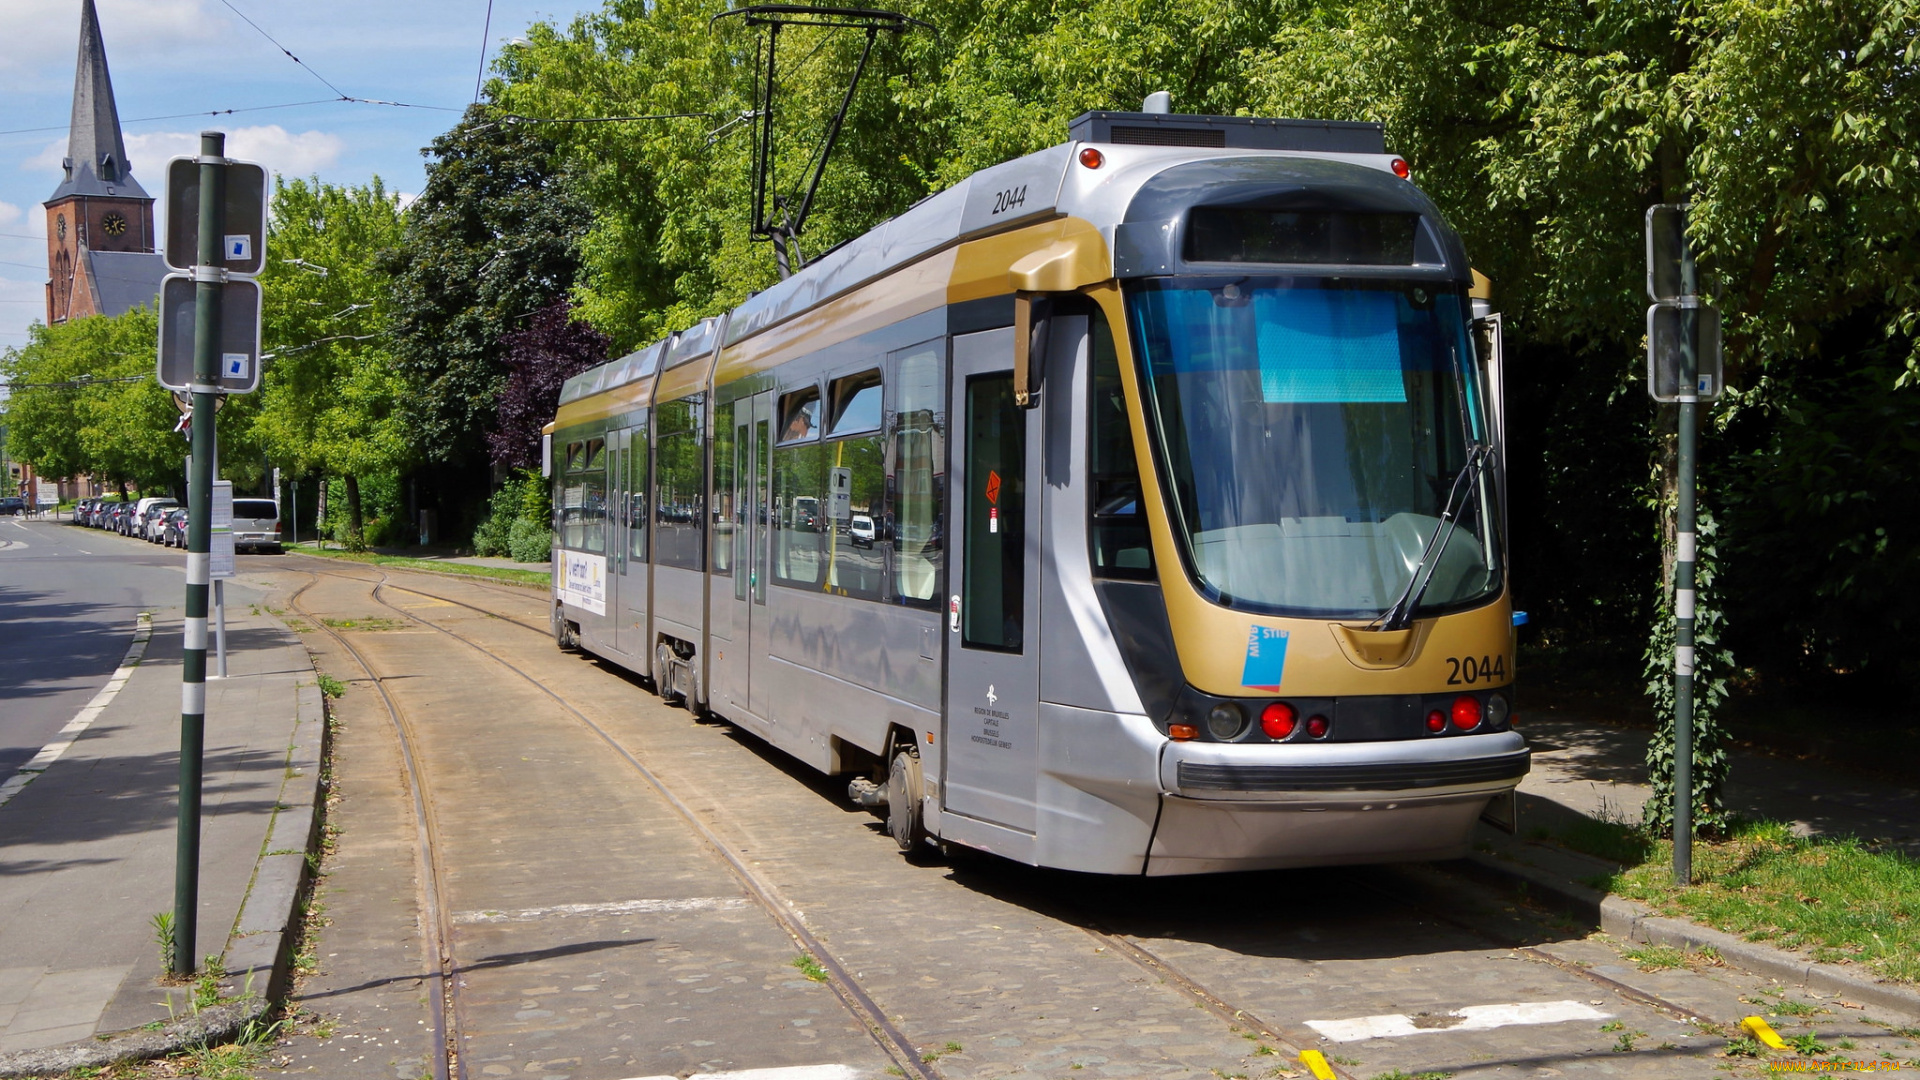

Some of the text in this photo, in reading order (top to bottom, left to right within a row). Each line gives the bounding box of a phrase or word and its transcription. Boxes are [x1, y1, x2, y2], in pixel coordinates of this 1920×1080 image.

[992, 184, 1027, 215] 2044
[1249, 626, 1260, 657] MIVB
[1263, 628, 1288, 639] STIB
[1446, 654, 1505, 685] 2044
